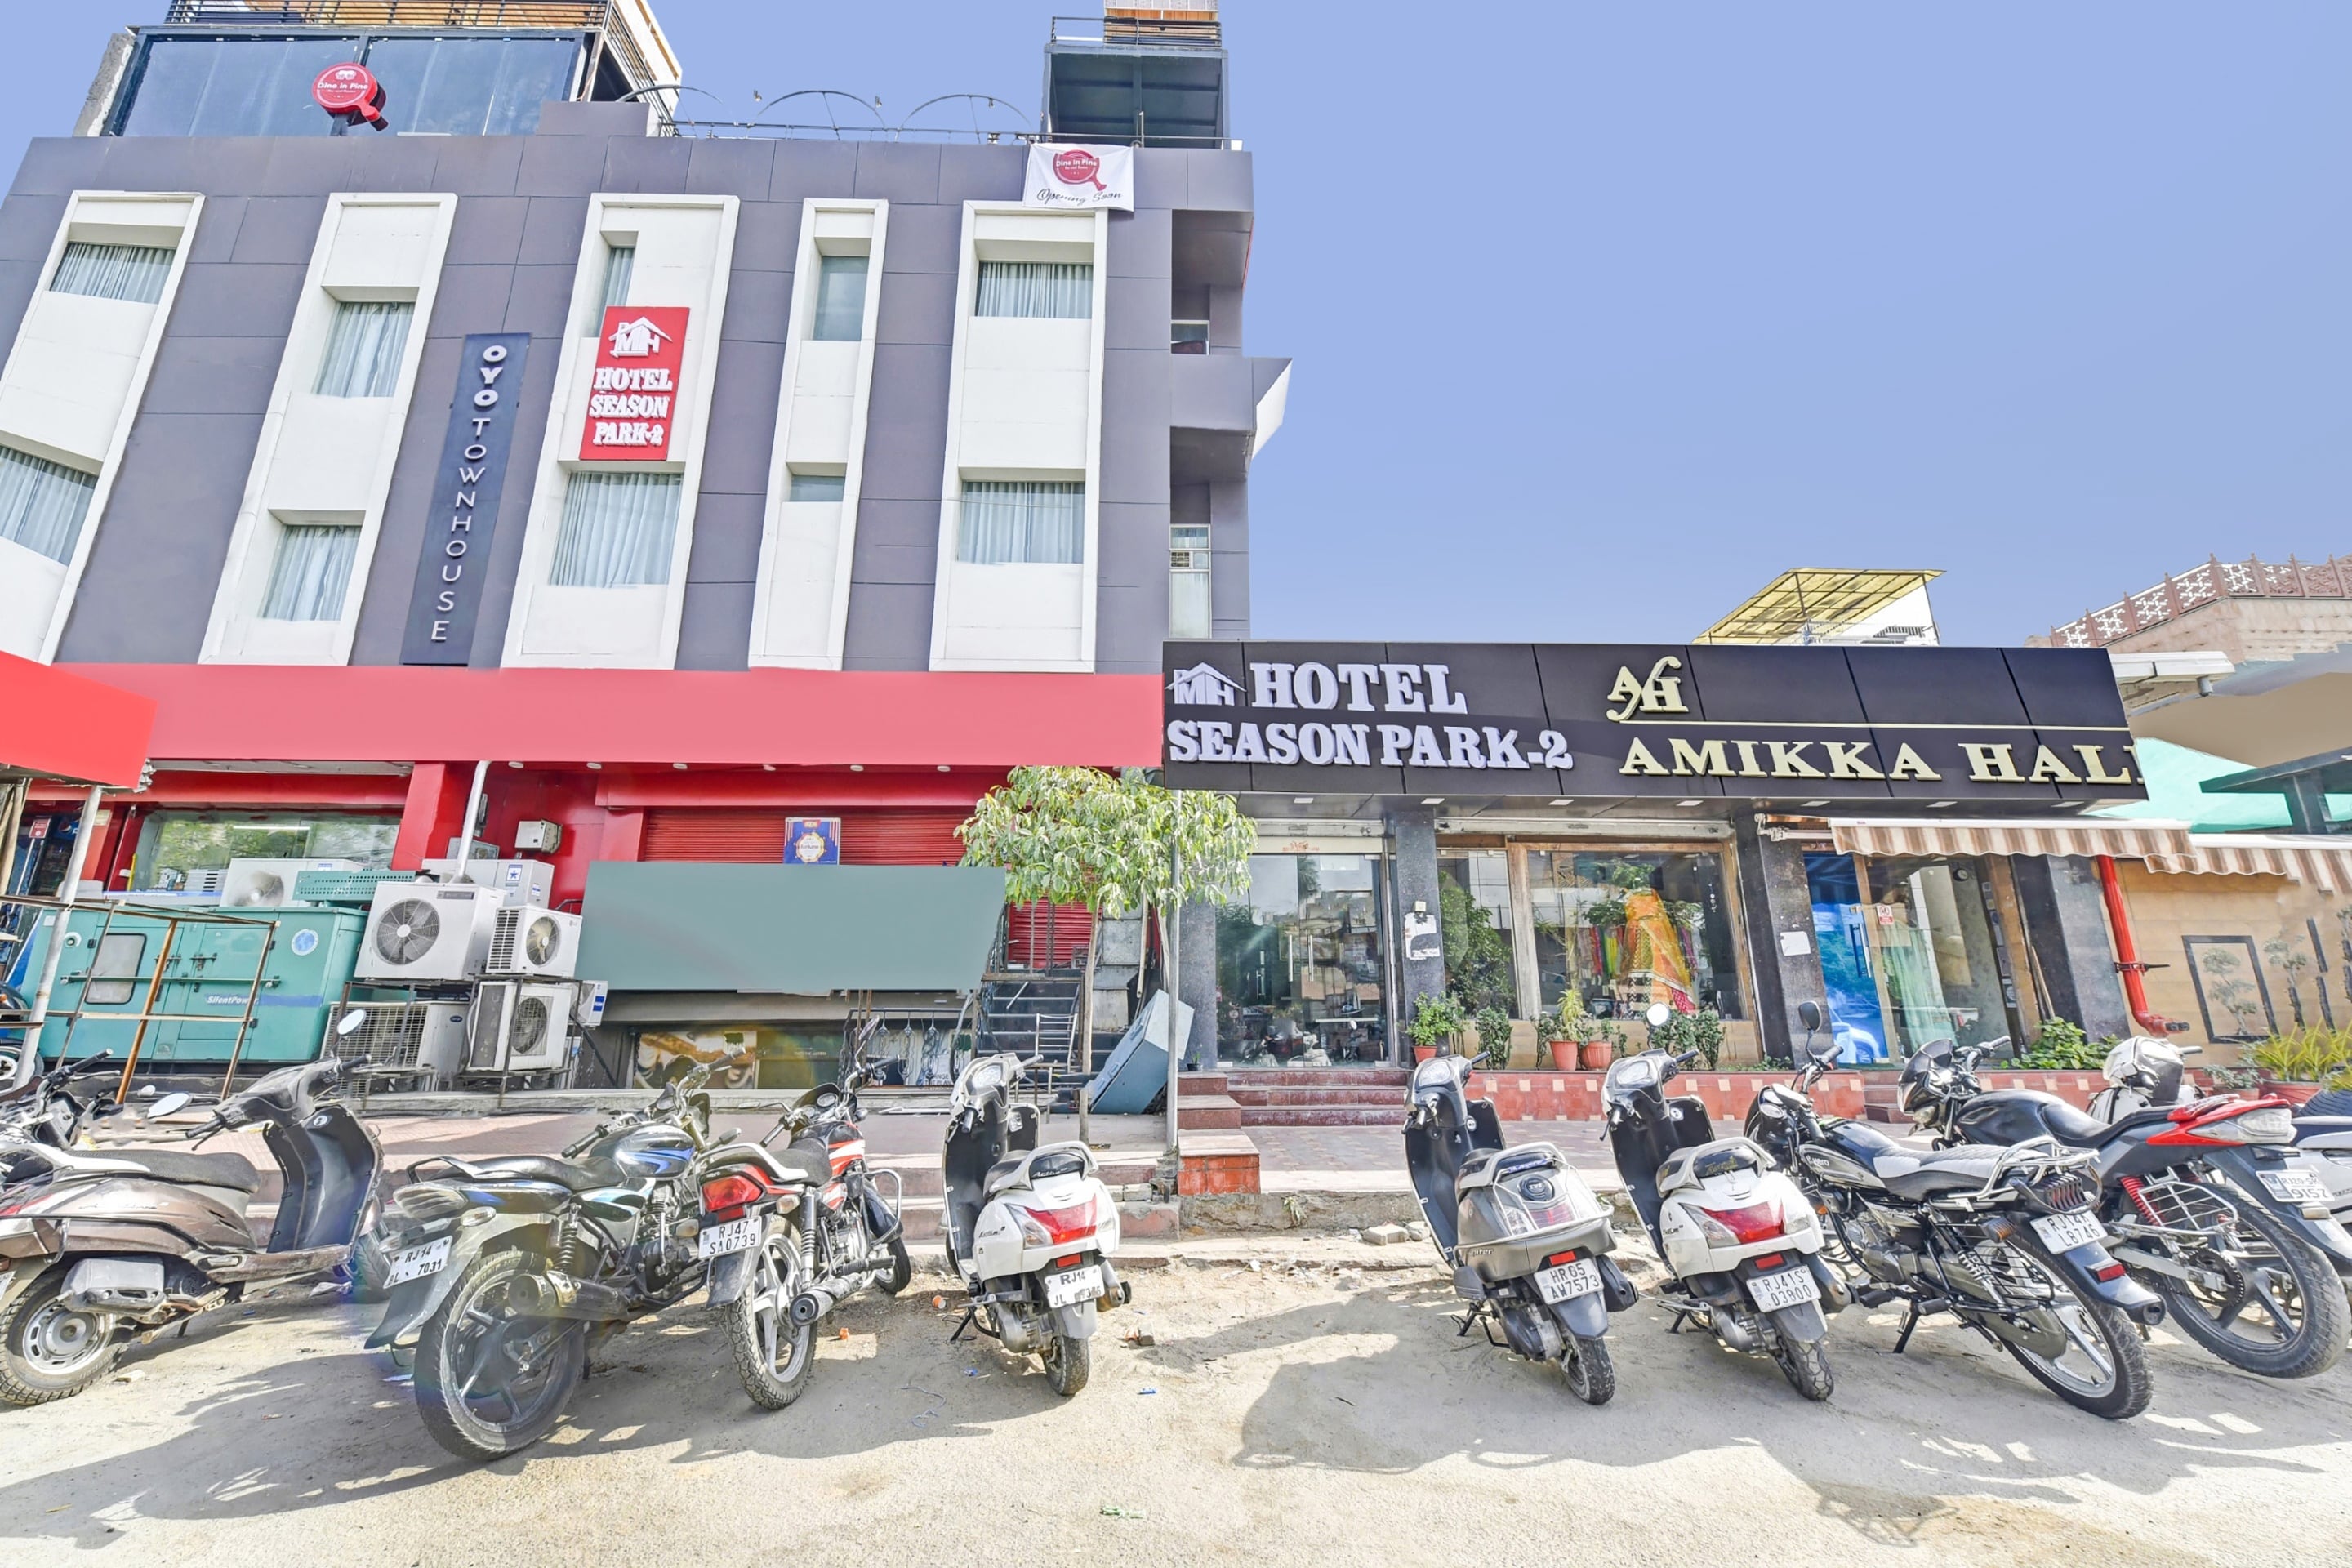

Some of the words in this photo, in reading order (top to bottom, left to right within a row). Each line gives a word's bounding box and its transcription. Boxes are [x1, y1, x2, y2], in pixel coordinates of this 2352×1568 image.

[1036, 188, 1086, 206] Opening
[1092, 191, 1123, 203] Soon
[594, 368, 673, 391] HOTEL
[589, 394, 670, 419] SEASON
[593, 421, 664, 446] PARK-2
[1250, 662, 1468, 715] HOTEL
[1167, 719, 1370, 766] SEASON
[1376, 724, 1575, 770] PARK-2
[1619, 737, 1942, 782] AMIKKA
[207, 996, 260, 1004] SilentPowr
[719, 1221, 749, 1240] RJ47
[710, 1233, 756, 1255] SA0739
[417, 1258, 442, 1276] 7031
[1060, 1270, 1086, 1285] RJ14
[1550, 1274, 1600, 1300] AW7573
